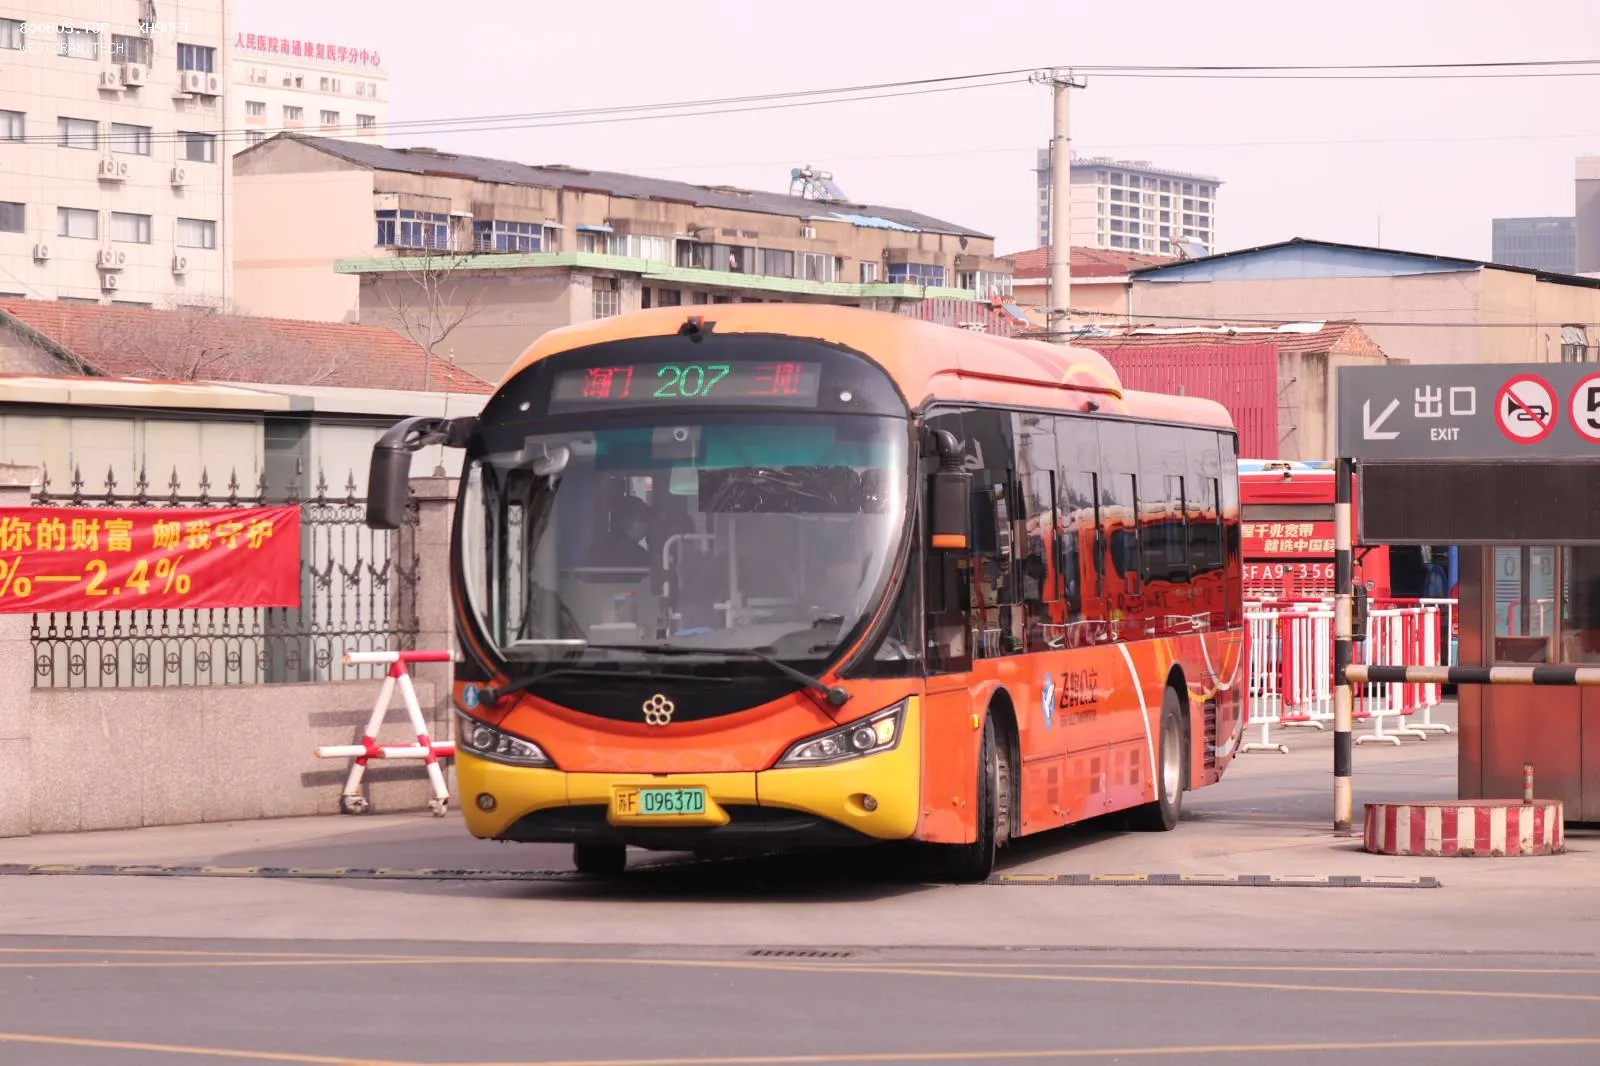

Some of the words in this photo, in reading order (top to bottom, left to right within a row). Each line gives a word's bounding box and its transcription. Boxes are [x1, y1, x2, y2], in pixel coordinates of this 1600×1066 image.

[653, 365, 730, 397] 207
[1414, 385, 1476, 418] 出口
[1430, 428, 1460, 441] EXIT
[0, 518, 133, 552] 你的财富
